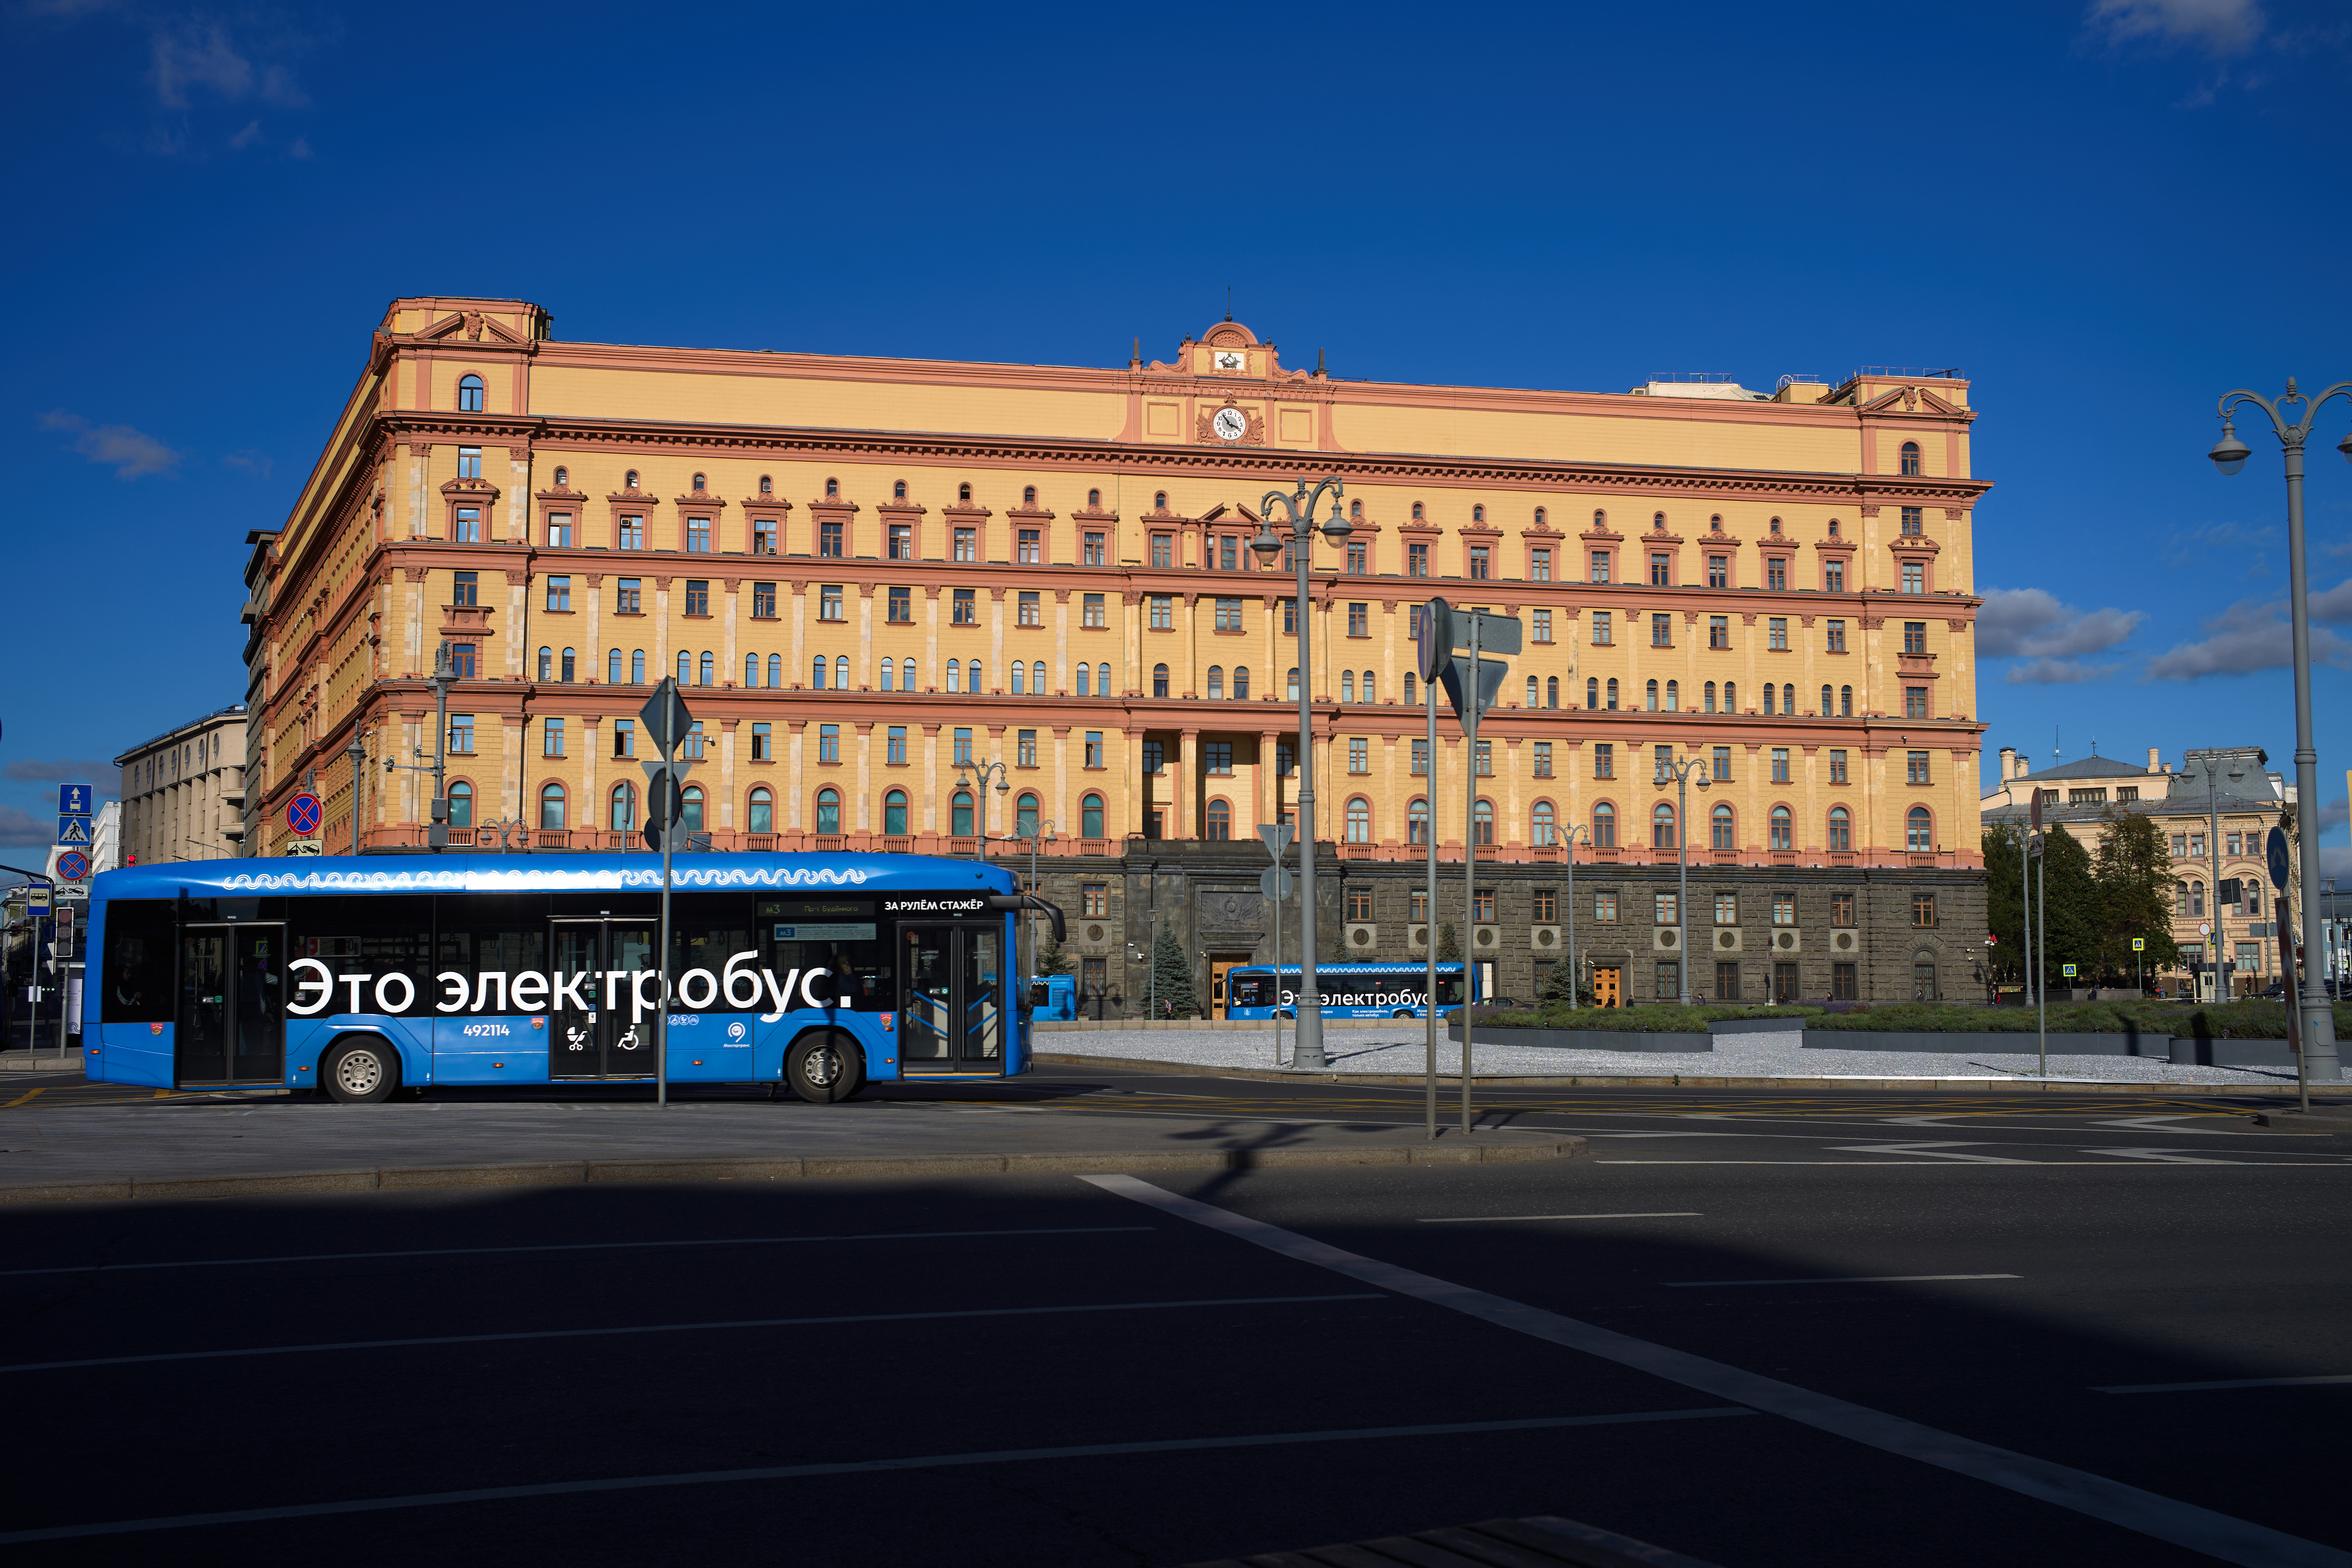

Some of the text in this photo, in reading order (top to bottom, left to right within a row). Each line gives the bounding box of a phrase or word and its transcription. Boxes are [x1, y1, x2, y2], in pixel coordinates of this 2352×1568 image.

[885, 899, 984, 910] ЗА РУЛЁМ СТАЖЁР
[286, 949, 851, 1023] Это электробус.
[463, 1024, 510, 1036] 492114
